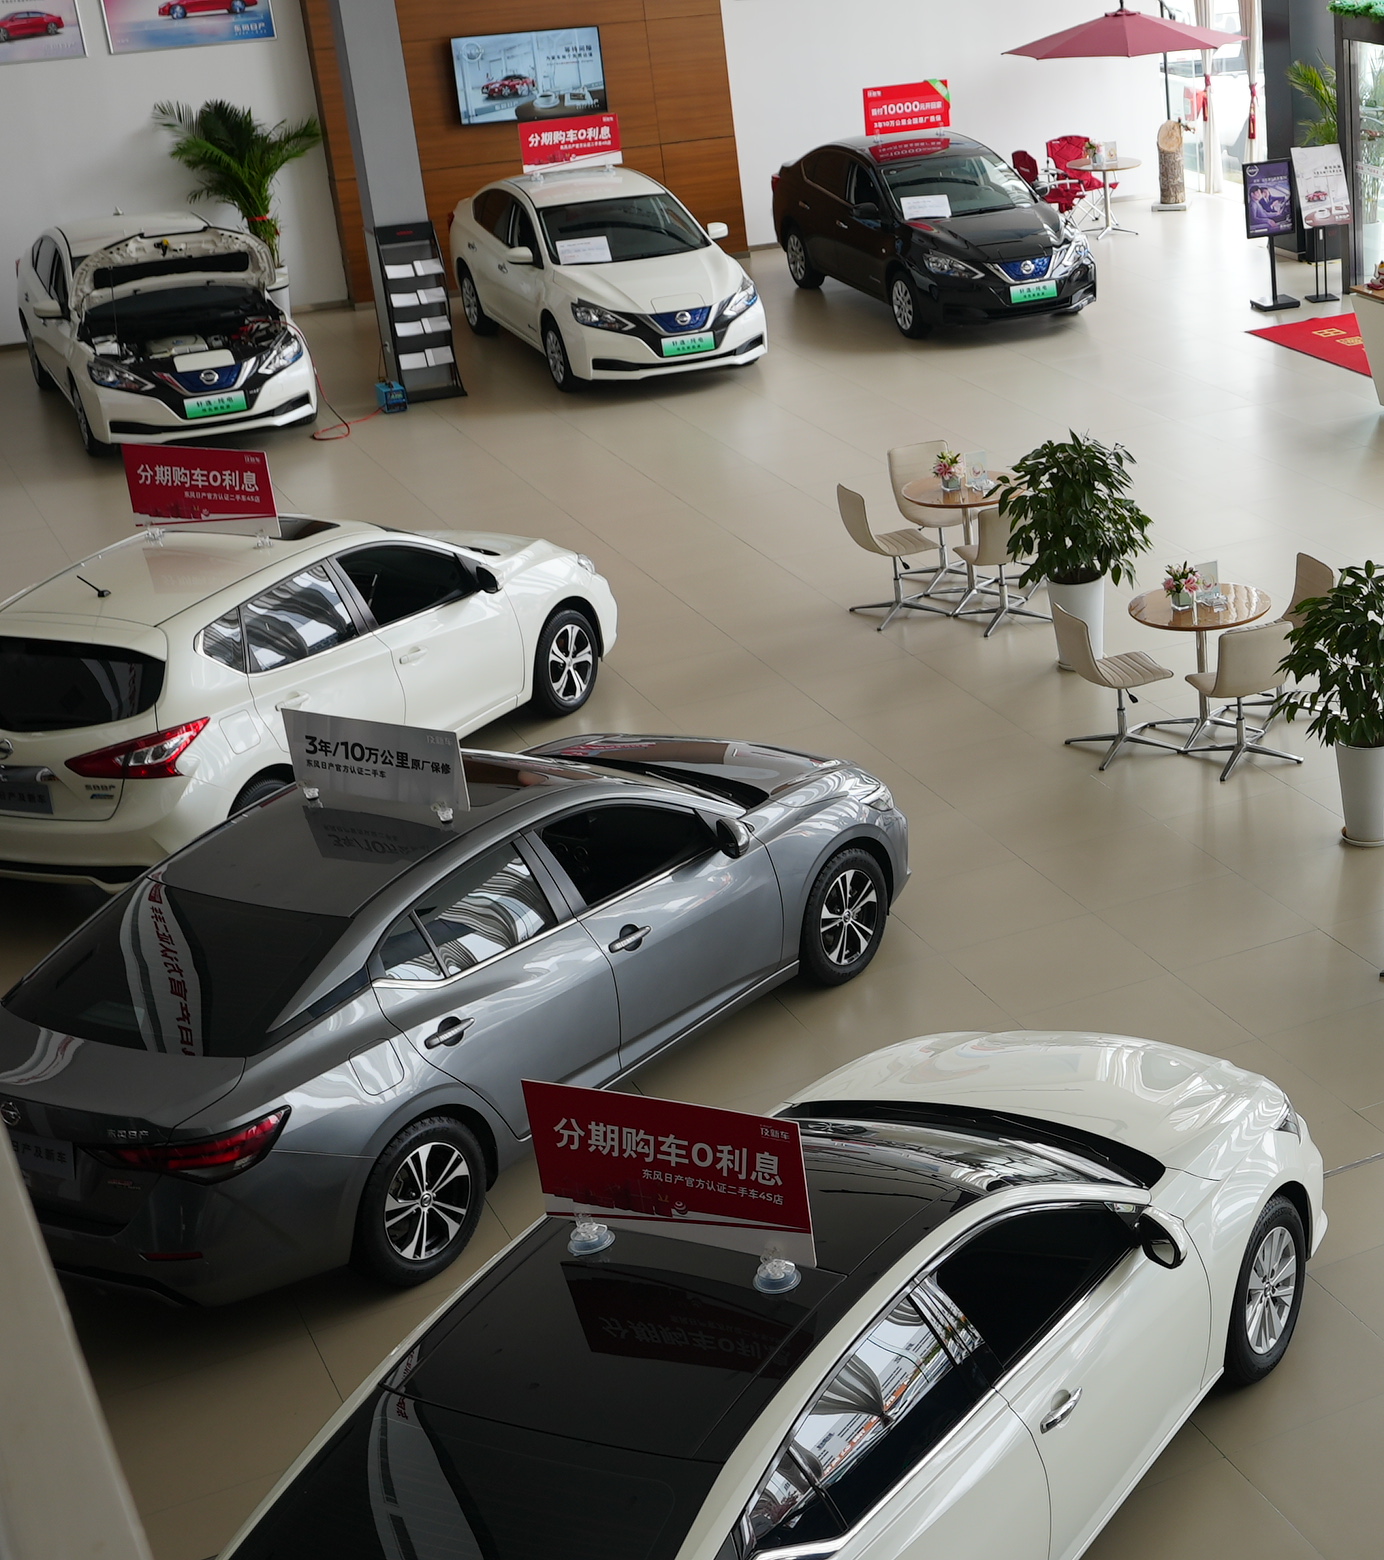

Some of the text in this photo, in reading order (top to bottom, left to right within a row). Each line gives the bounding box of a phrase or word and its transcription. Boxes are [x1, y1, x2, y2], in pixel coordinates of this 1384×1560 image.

[137, 463, 259, 492] 分期购车0利息
[306, 759, 387, 778] 东风日产官方认证二手车
[760, 1127, 790, 1140] 及新车
[553, 1117, 783, 1186] 分期购车0利息
[642, 1168, 784, 1206] 东风日产官方认证二手车4S店
